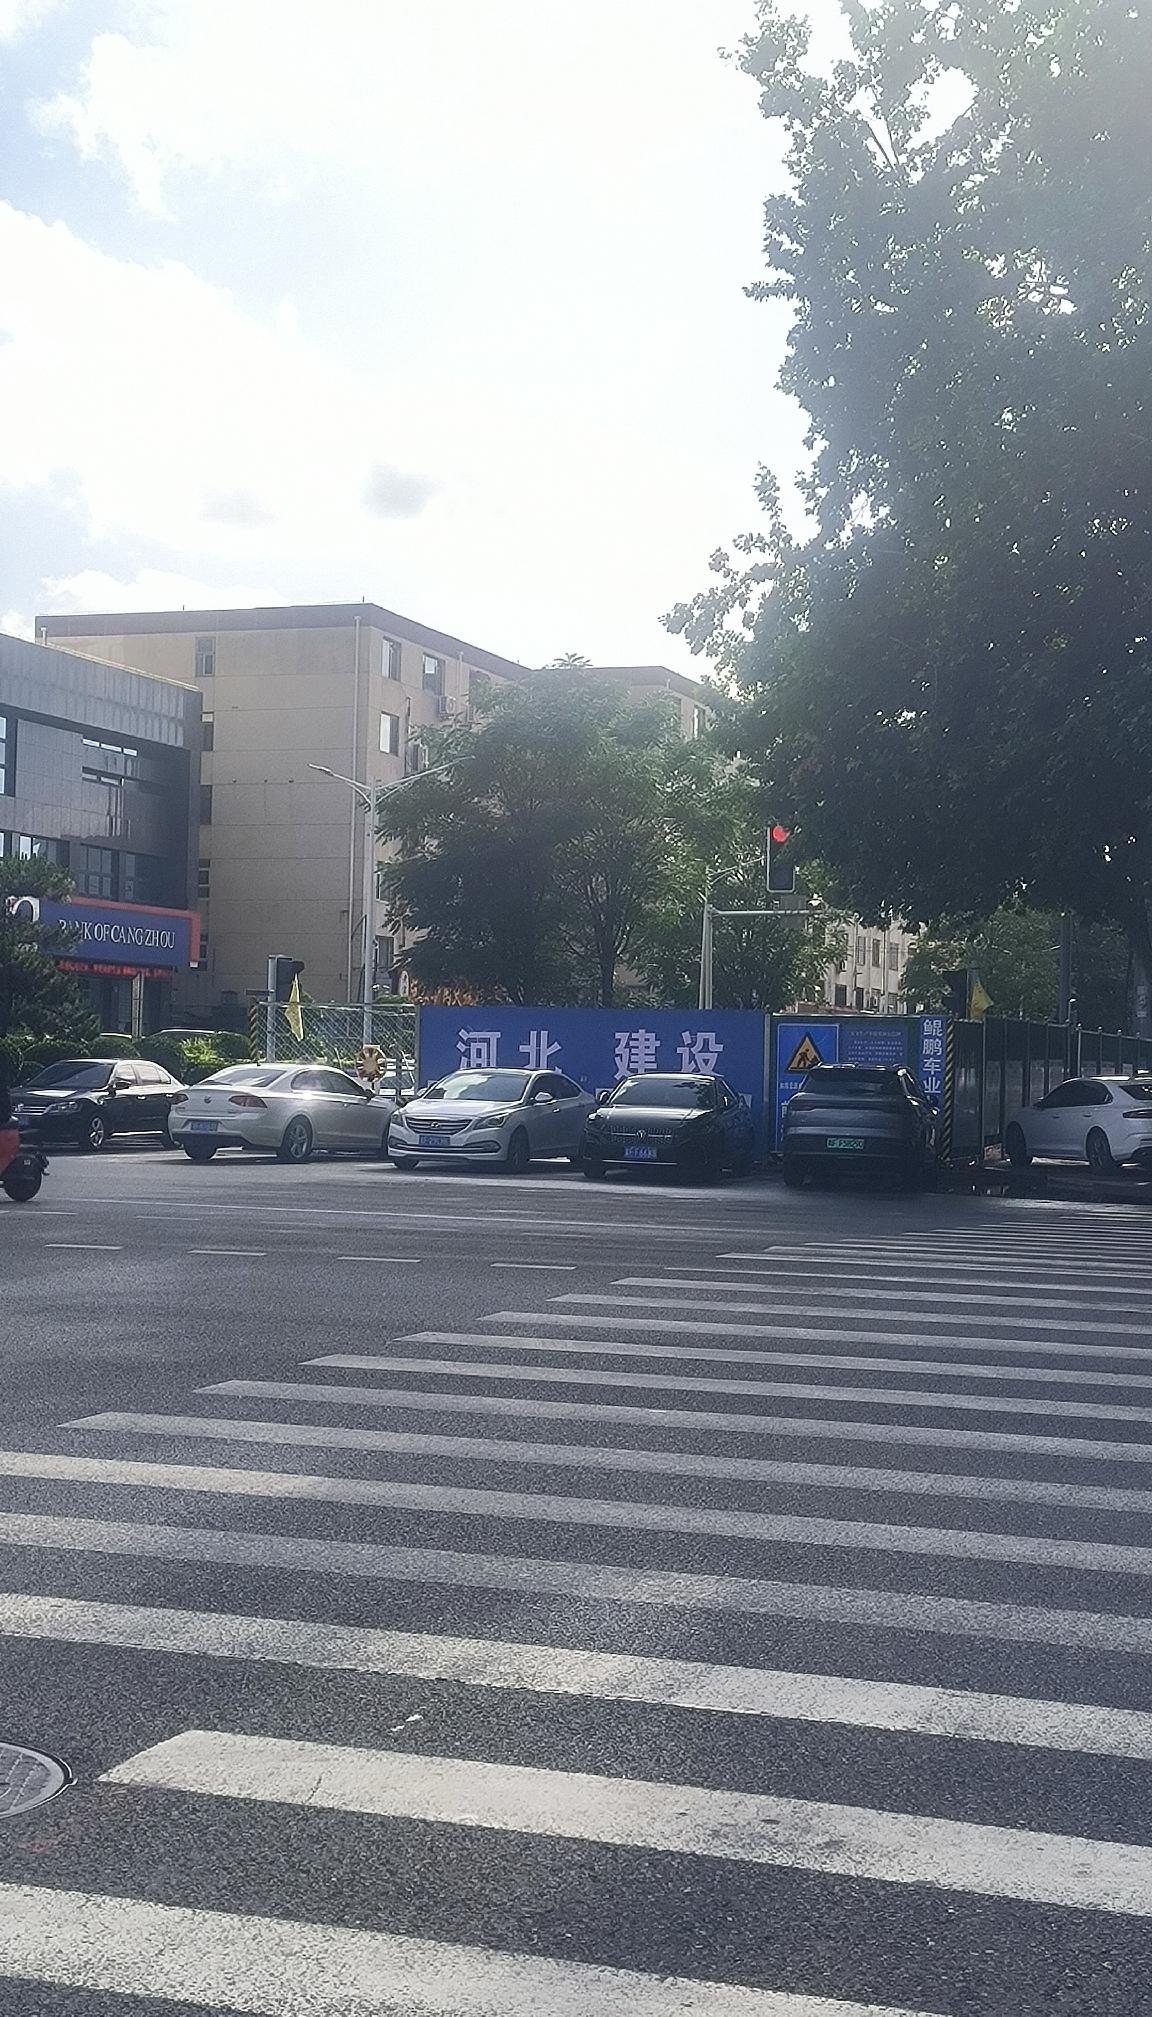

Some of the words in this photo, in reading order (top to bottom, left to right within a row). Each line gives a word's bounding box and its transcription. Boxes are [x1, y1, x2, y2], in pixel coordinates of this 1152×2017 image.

[456, 1028, 563, 1073] 河北
[614, 1028, 725, 1081] 建设
[922, 1019, 943, 1094] 鲲鹏车业
